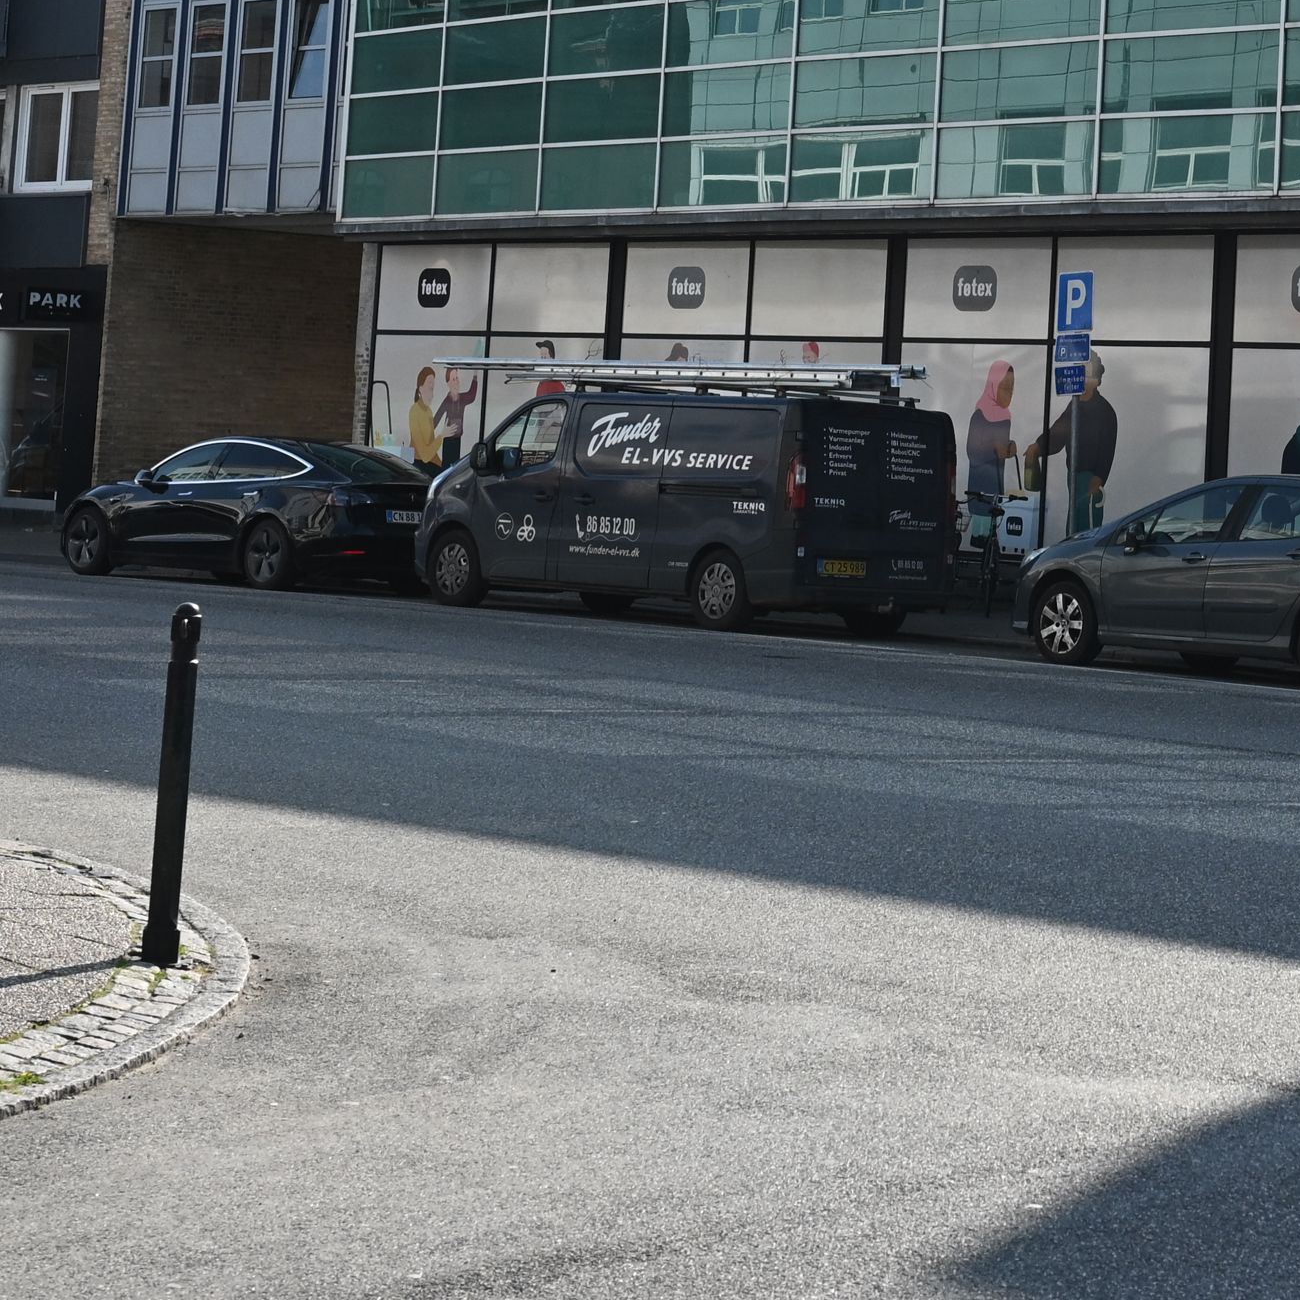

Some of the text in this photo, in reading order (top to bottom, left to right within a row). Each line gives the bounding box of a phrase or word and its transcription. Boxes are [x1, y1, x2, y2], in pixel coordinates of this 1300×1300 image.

[421, 278, 448, 296] føtex
[671, 277, 702, 296] føtex
[957, 276, 993, 297] føtex
[29, 291, 82, 309] PARK
[1066, 279, 1087, 325] P
[587, 411, 662, 458] Funder
[621, 447, 754, 471] EL-VVS SERVICE
[732, 501, 766, 512] TEKNIQ
[814, 497, 846, 507] TEKNIQ
[393, 512, 404, 521] CN
[405, 512, 415, 522] 88
[587, 515, 636, 536] 86 85 12 00
[569, 544, 641, 558] www.funder-el-vvs.dk
[825, 562, 836, 572] CT
[838, 562, 849, 573] 25
